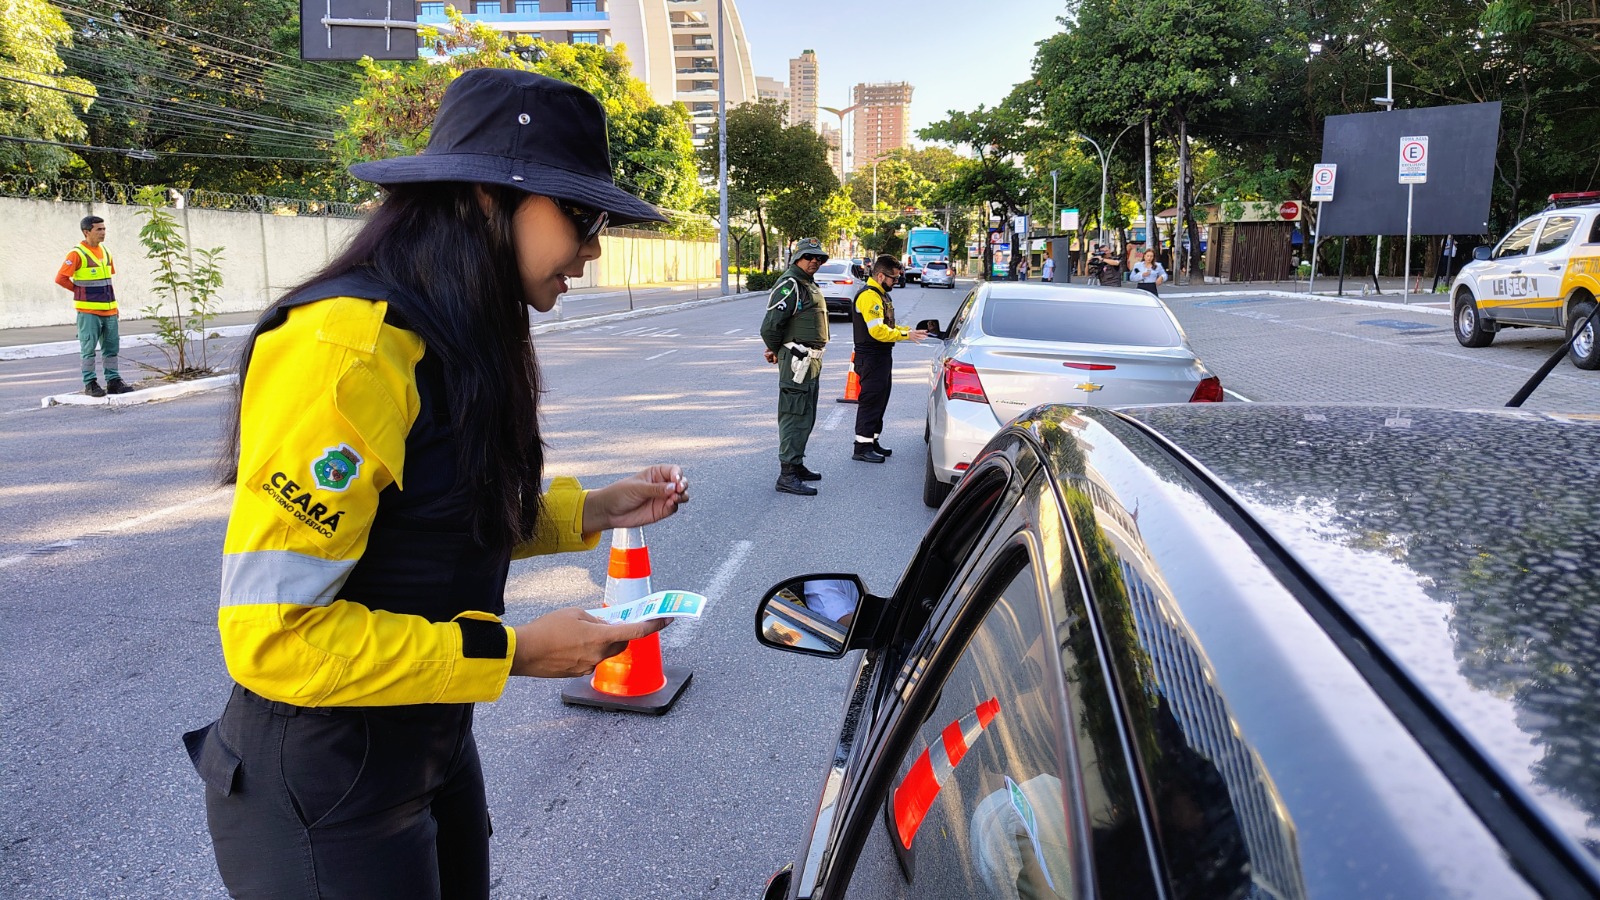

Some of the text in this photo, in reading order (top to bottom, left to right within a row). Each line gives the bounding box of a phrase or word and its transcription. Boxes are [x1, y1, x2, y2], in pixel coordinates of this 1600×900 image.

[1409, 147, 1418, 159] E
[1321, 172, 1328, 182] E
[1493, 276, 1539, 297] LEI SECA
[262, 483, 333, 539] GOVERNO DO ESTADO
[270, 471, 346, 532] CEARÁ
